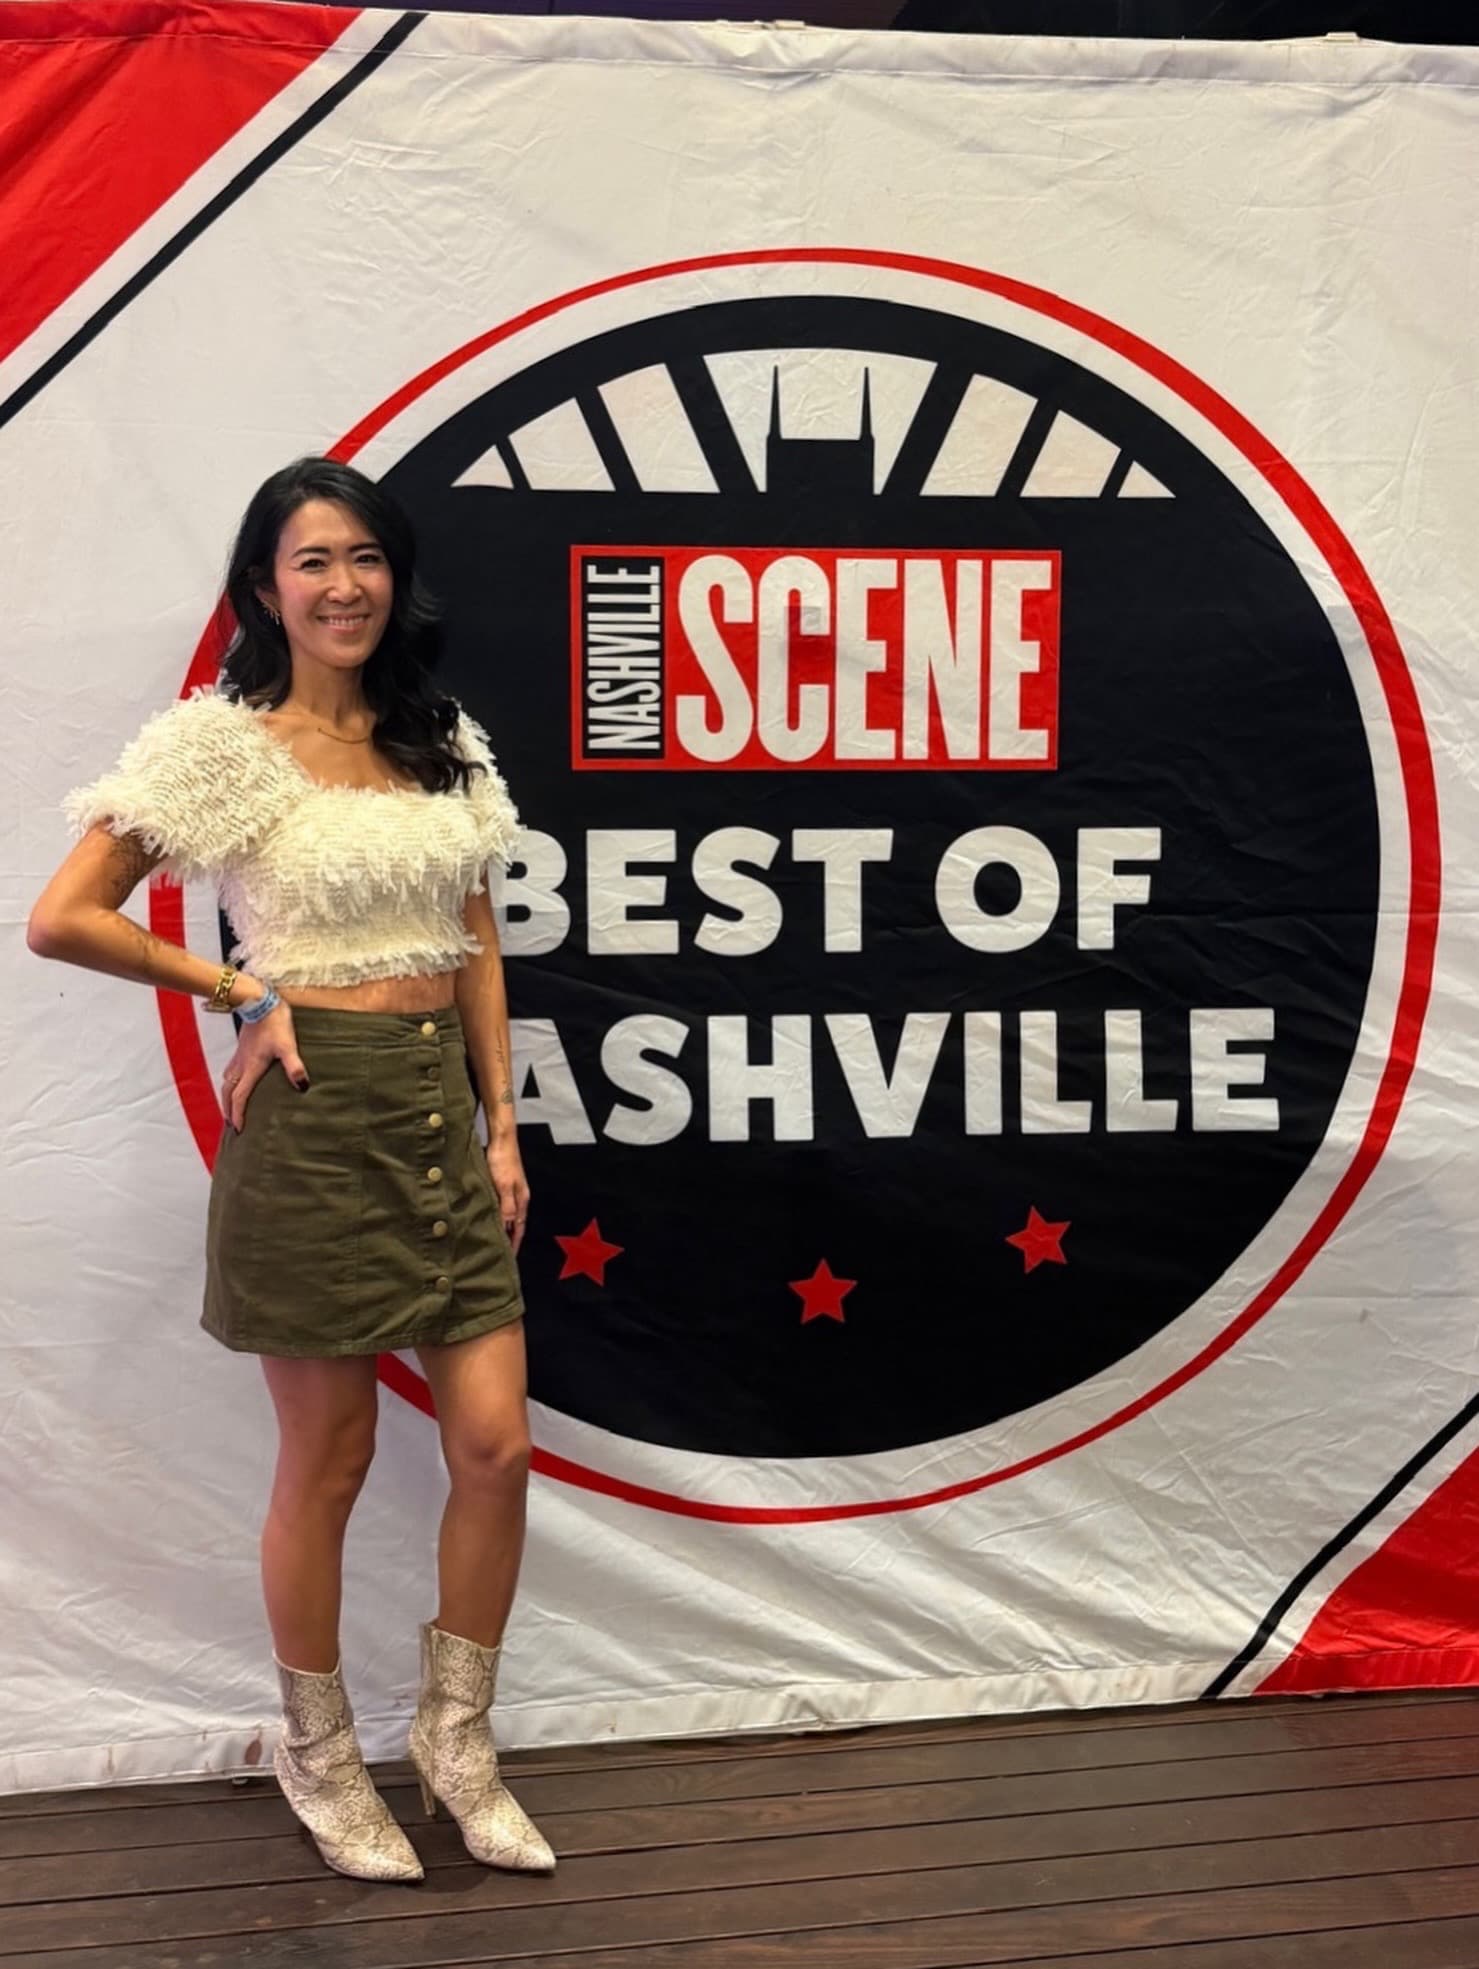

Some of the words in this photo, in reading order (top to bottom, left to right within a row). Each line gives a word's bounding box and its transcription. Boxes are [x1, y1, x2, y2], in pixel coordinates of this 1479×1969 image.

[587, 564, 661, 750] NASHVILLE
[676, 554, 1052, 762] SCENE
[488, 826, 894, 956] BEST
[935, 825, 1162, 953] OF
[475, 1008, 1280, 1145] ASHVILLE
